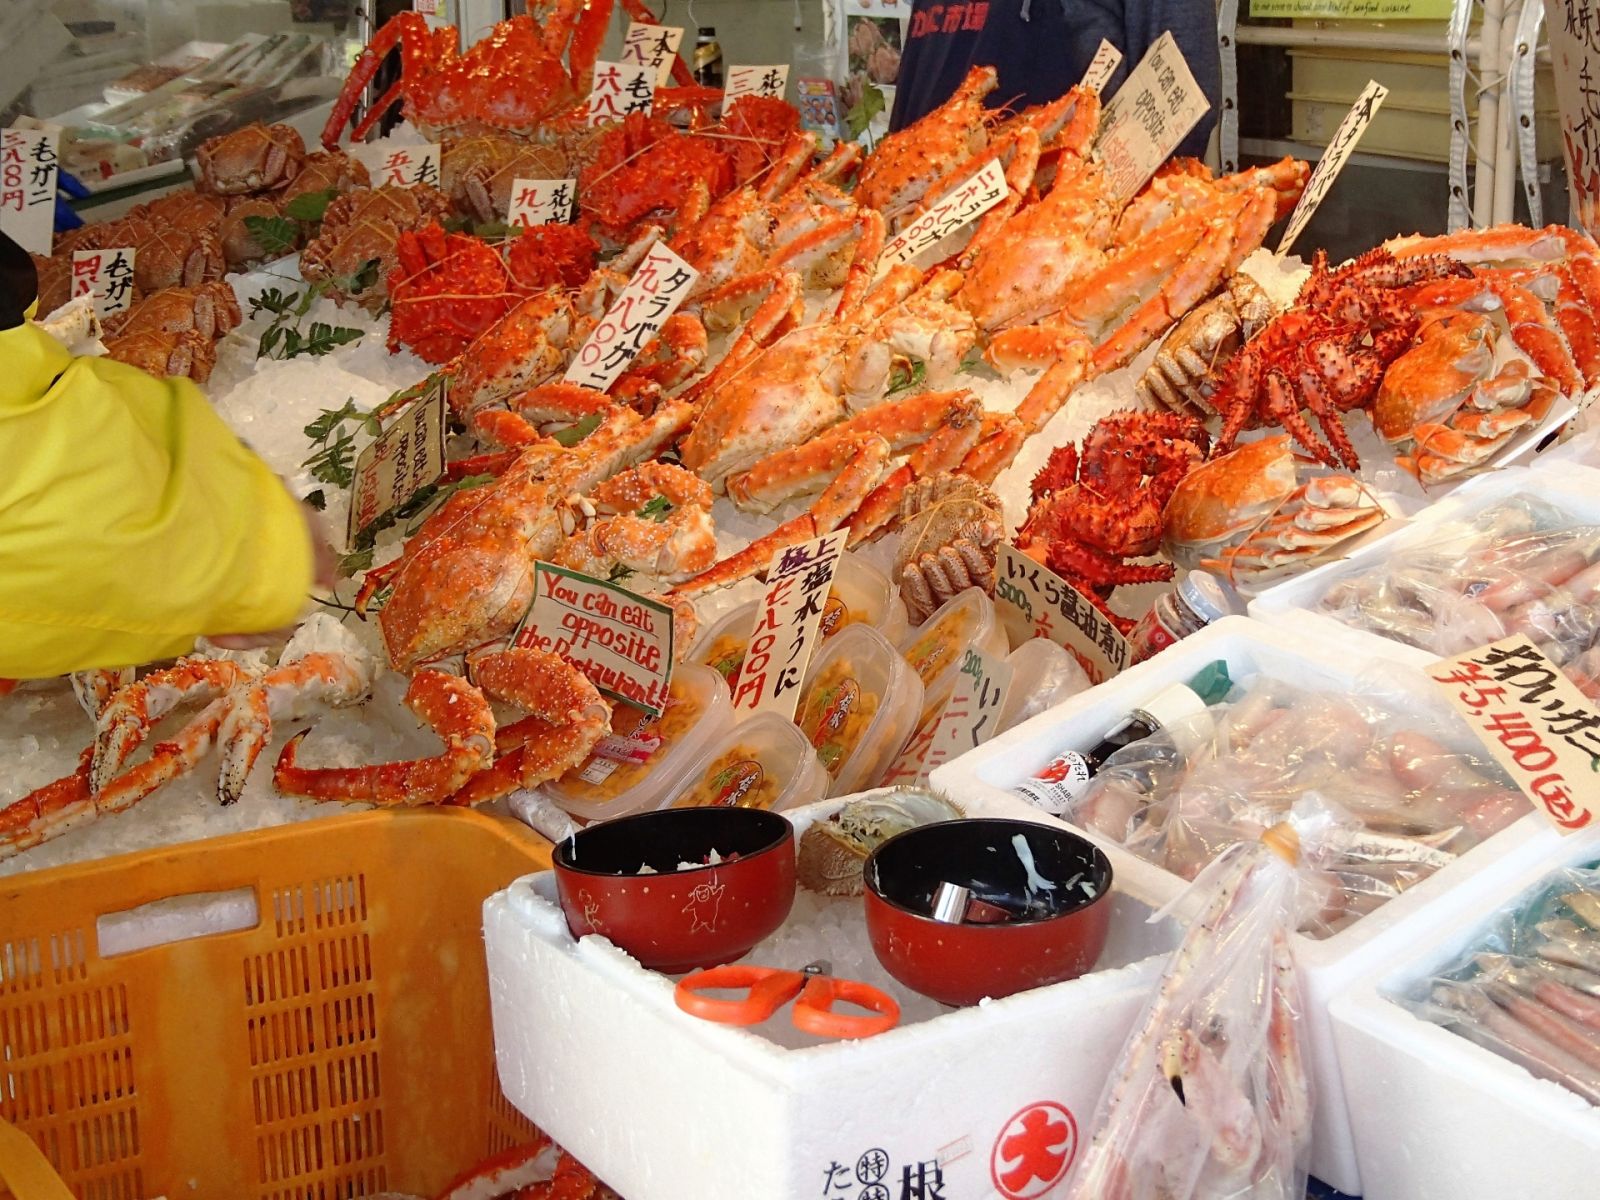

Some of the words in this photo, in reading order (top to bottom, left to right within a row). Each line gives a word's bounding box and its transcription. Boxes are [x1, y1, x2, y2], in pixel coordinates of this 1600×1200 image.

[1158, 66, 1177, 95] can
[1168, 85, 1188, 116] eat
[580, 267, 691, 391] タラバガニ
[542, 570, 579, 605] You
[582, 592, 618, 619] can
[621, 605, 654, 633] eat
[996, 576, 1032, 623] 500g
[515, 624, 552, 652] the
[561, 612, 661, 673] opposite
